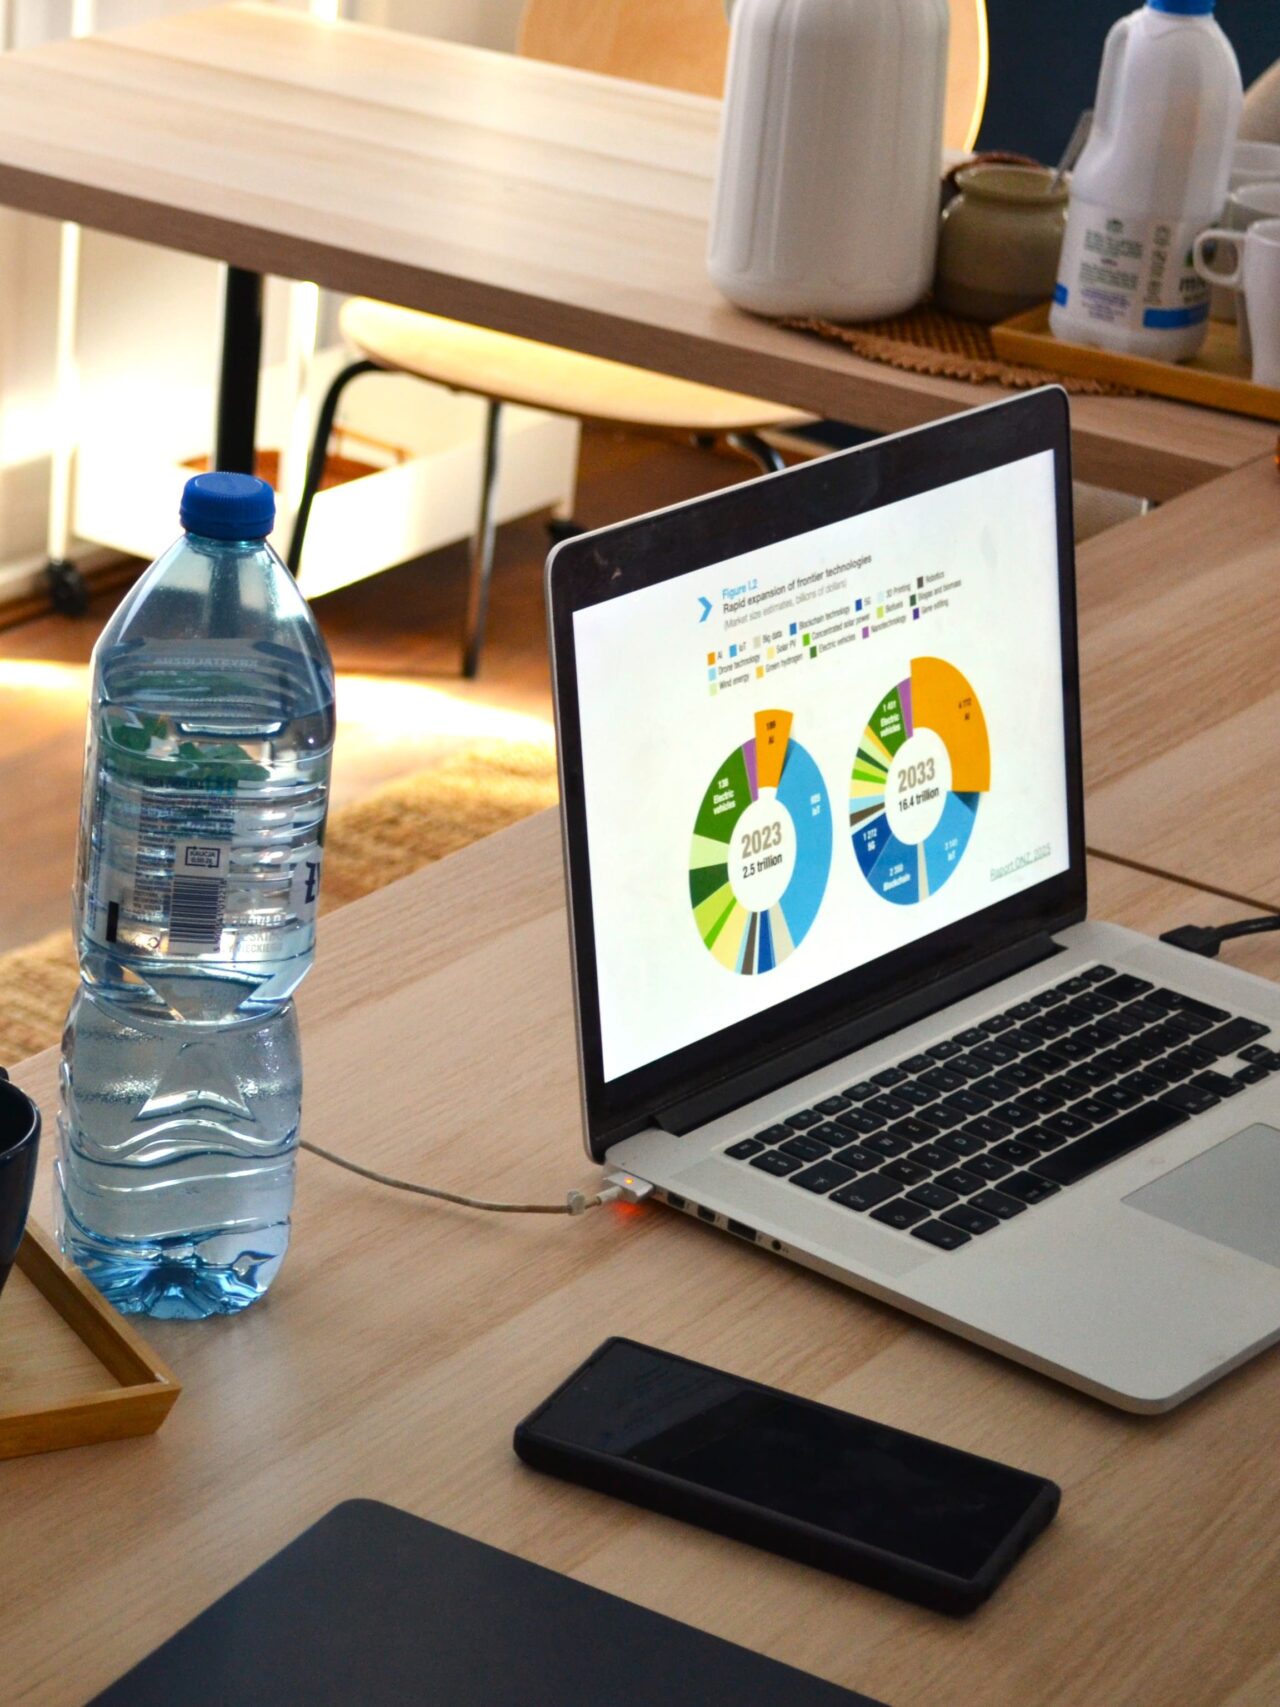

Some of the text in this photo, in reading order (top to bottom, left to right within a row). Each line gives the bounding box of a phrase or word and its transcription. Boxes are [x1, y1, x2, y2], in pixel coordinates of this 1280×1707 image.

[722, 583, 747, 600] Figure
[723, 554, 872, 614] Rapid expansion of frontier technologies
[817, 586, 825, 597] of
[825, 606, 851, 622] technology
[812, 613, 870, 640] Concentrated solar power
[772, 630, 783, 641] data
[818, 634, 856, 653] Electric vehicles
[776, 643, 788, 654] Solar
[718, 654, 761, 676] Drone technology
[766, 653, 804, 673] Green hydrogen
[719, 674, 750, 690] Wind energy
[879, 714, 900, 728] Electric
[879, 723, 902, 738] vehicles
[898, 757, 936, 793] 2033
[712, 789, 736, 805] Electric
[898, 786, 941, 813] 16.4 trillion
[712, 800, 737, 816] vehicles
[741, 821, 782, 860] 2023
[190, 850, 216, 859] KAUCJA
[742, 852, 783, 879] 2.5 trillion
[989, 860, 1013, 882] Report
